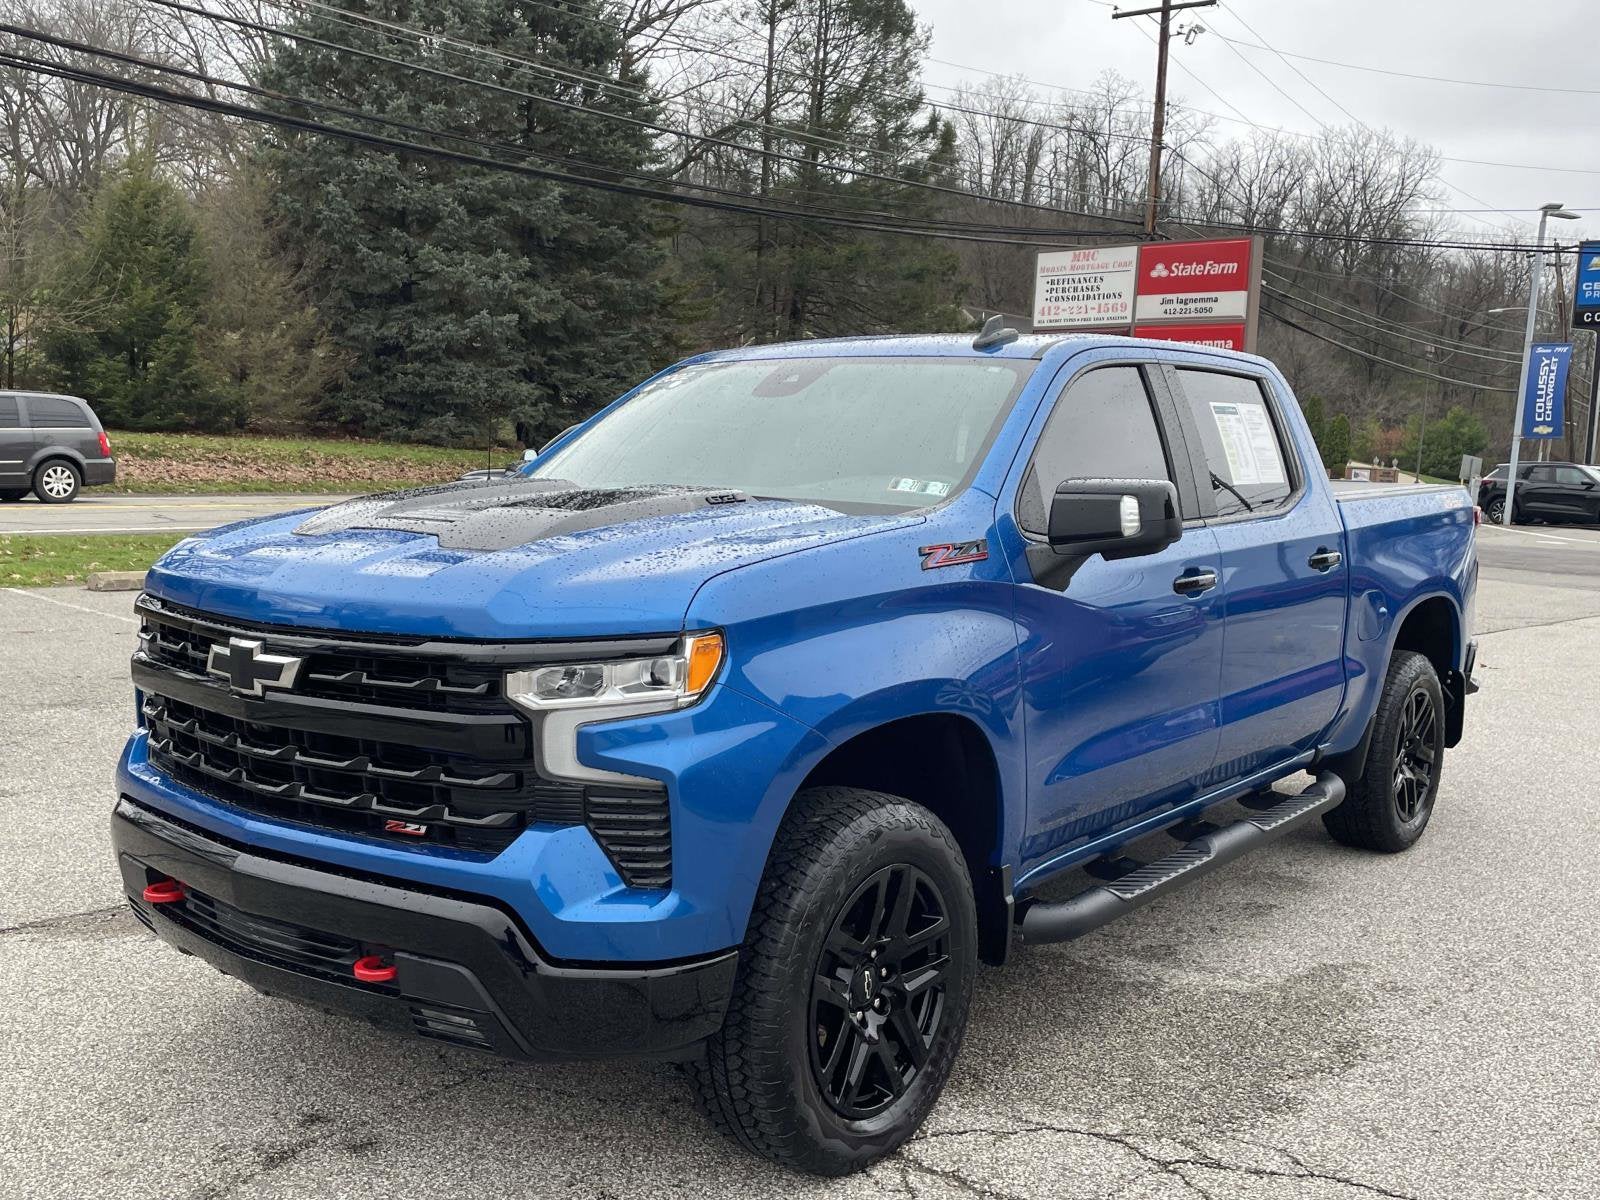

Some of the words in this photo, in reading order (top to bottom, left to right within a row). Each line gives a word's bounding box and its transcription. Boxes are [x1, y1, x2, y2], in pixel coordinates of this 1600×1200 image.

[1160, 297, 1174, 305] Jim
[1163, 307, 1213, 315] 412-221-5050
[1535, 356, 1551, 422] COLUSSY
[1545, 356, 1559, 422] CHEVROLET
[918, 539, 989, 571] Z71
